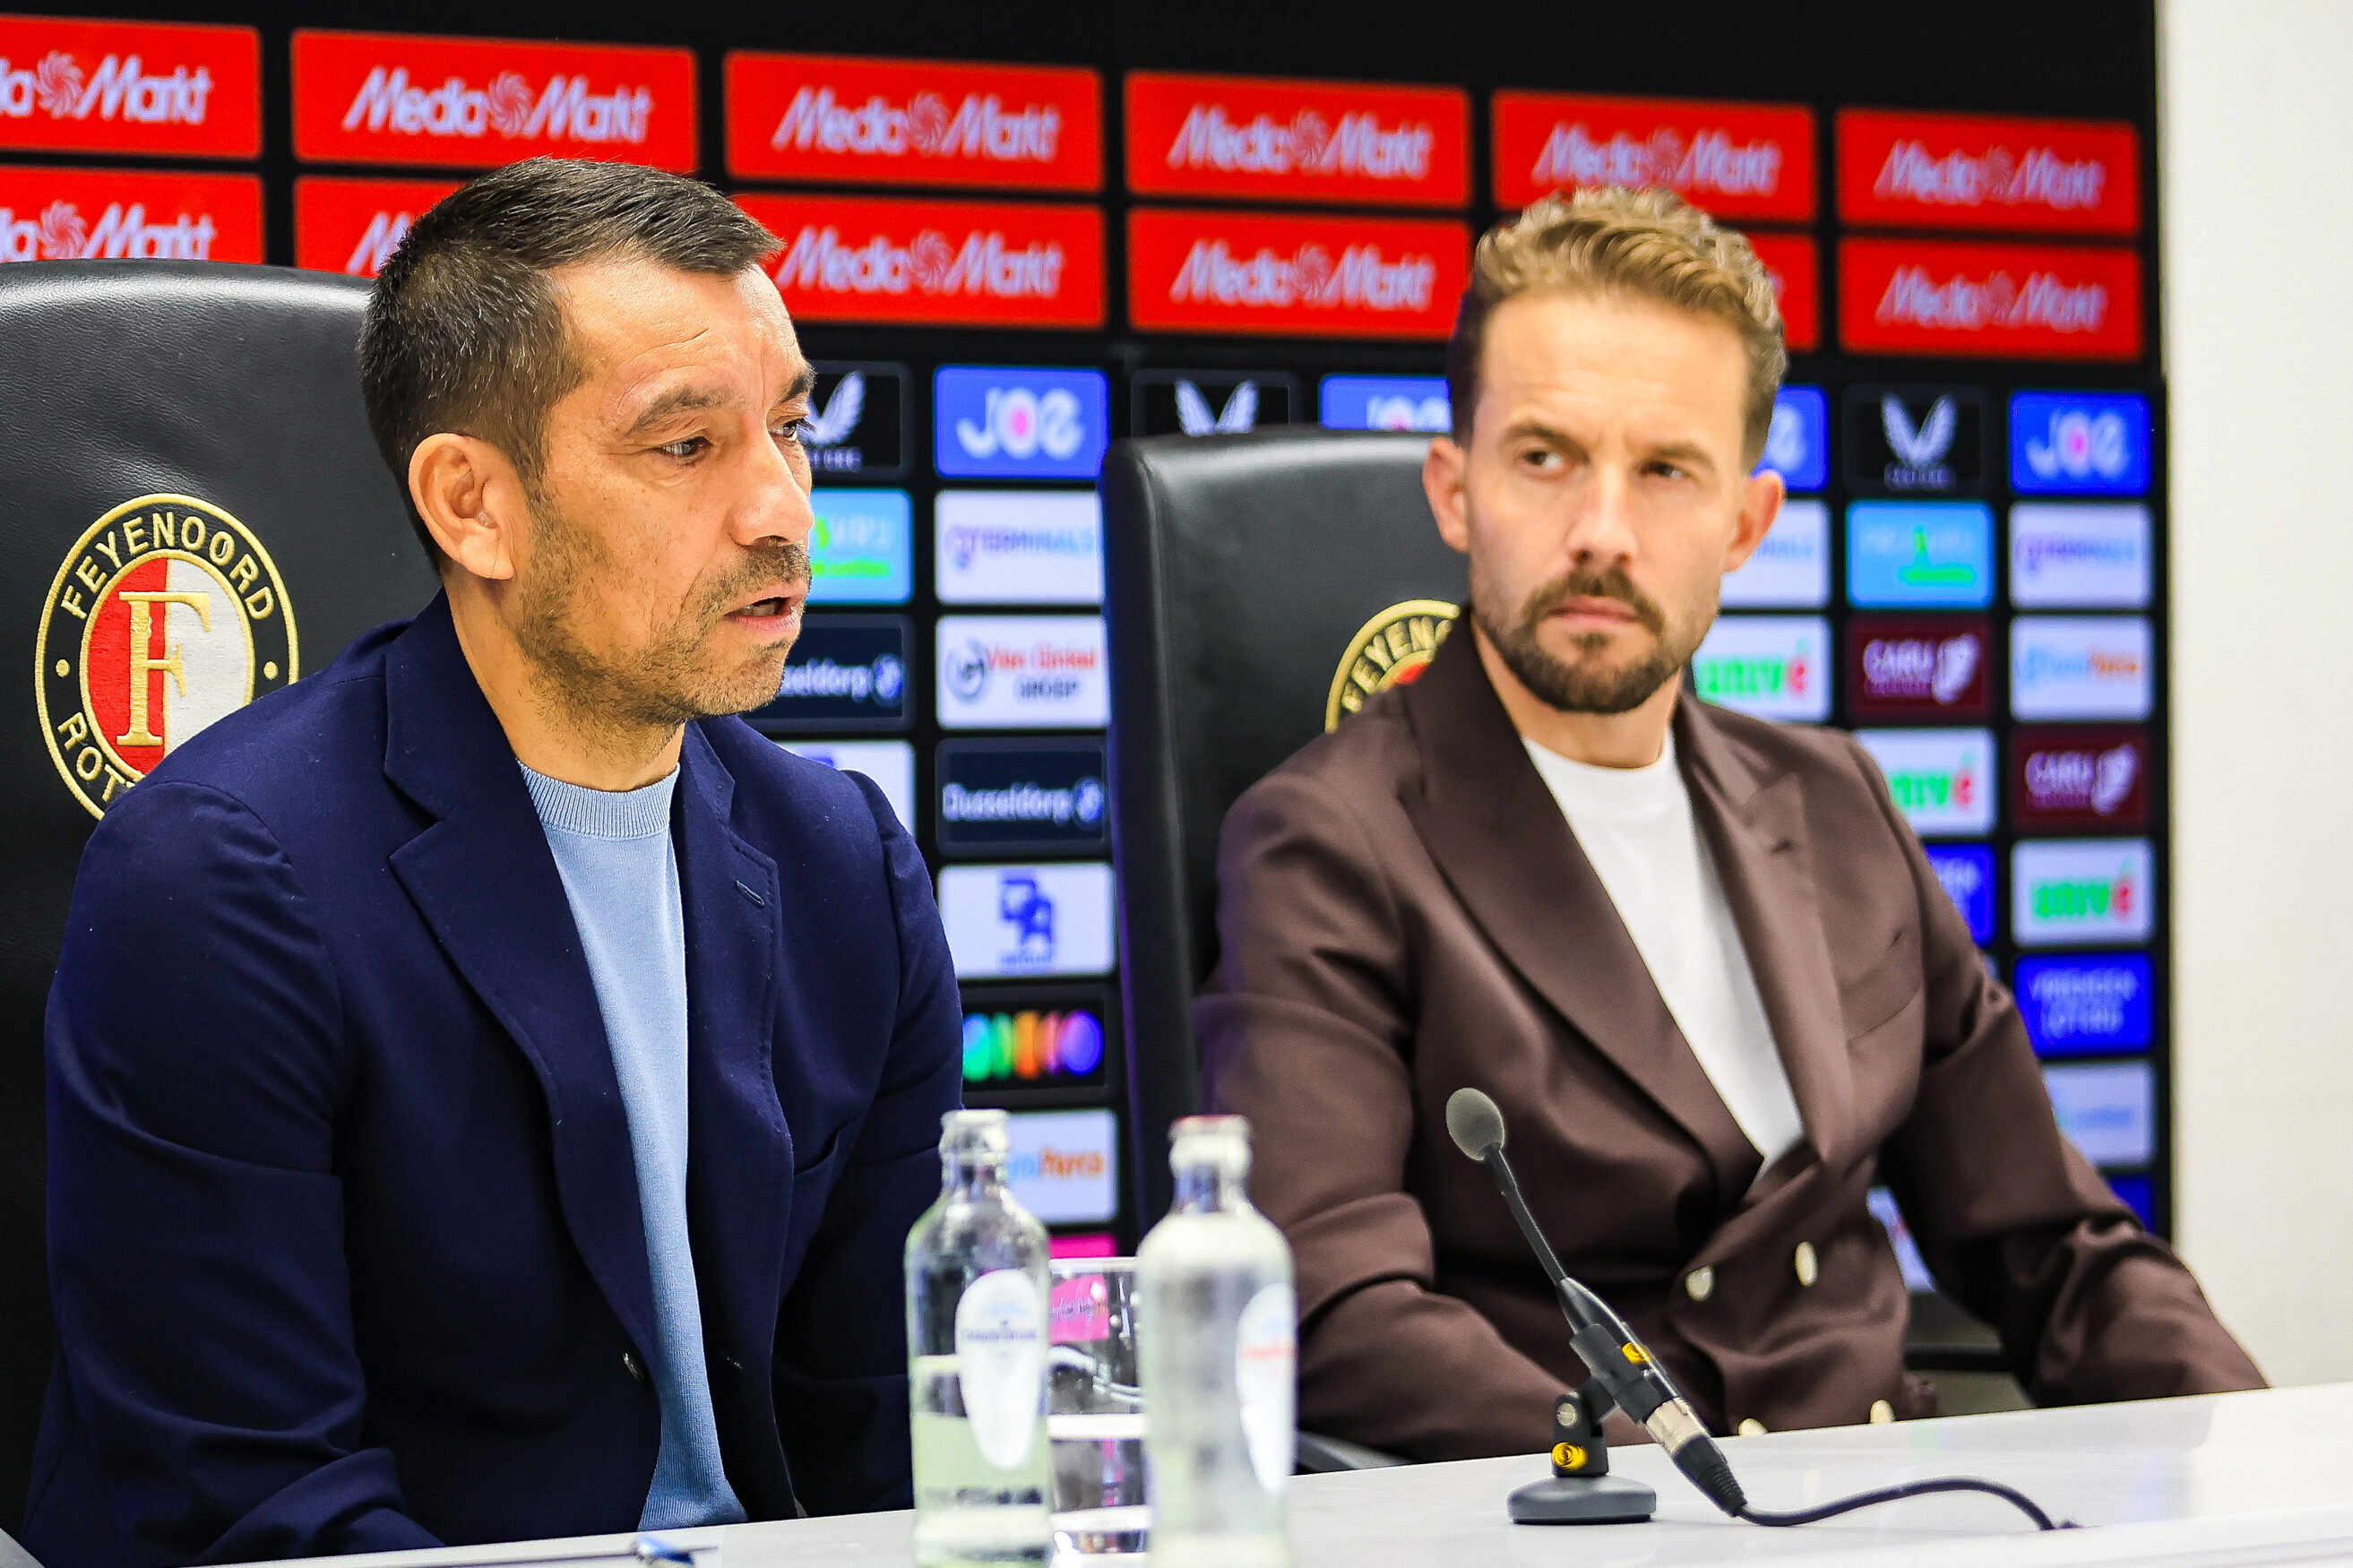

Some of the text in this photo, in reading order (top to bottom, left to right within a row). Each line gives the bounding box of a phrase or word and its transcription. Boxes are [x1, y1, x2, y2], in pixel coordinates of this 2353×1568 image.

[60, 511, 274, 620] FEYENOORD
[116, 590, 211, 746] F
[57, 712, 135, 803] ROT
